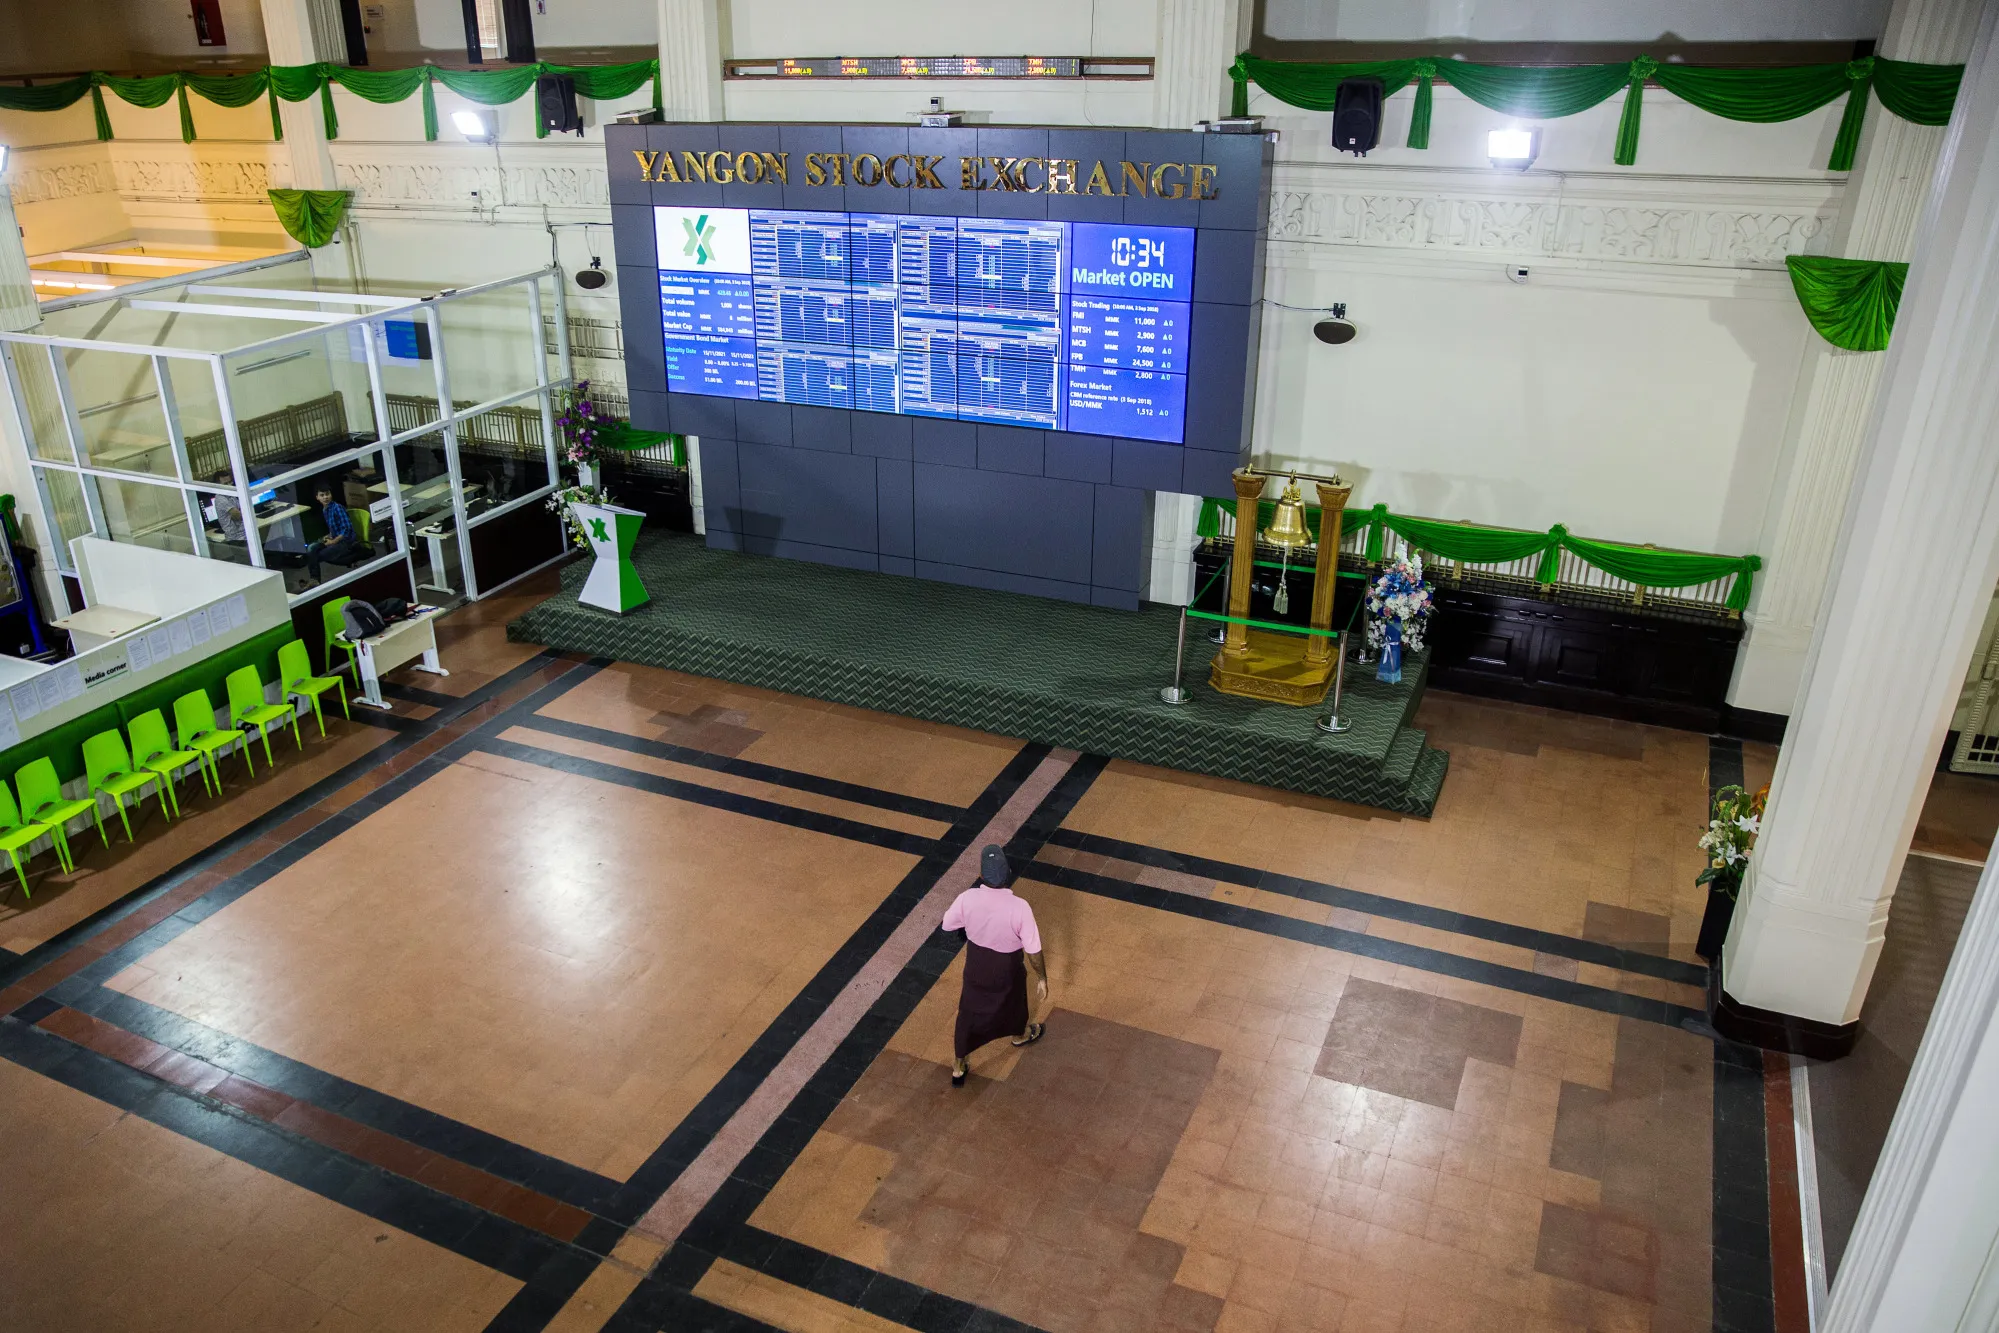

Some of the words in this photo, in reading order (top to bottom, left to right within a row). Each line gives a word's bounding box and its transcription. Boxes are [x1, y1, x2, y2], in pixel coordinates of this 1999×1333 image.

[632, 150, 788, 186] YANGON
[805, 152, 946, 190] STOCK
[958, 156, 1220, 200] EXCHANGE
[1111, 237, 1164, 268] 10:34
[1072, 268, 1126, 286] Market
[1129, 271, 1174, 289] OPEN
[662, 297, 675, 305] Total
[1089, 302, 1110, 311] Trading
[663, 309, 676, 317] Total
[1134, 318, 1155, 326] 11,000
[683, 323, 693, 331] Cap
[665, 333, 695, 341] Government
[1072, 326, 1091, 334] MTSH
[1137, 332, 1155, 340] 2,900
[1072, 339, 1086, 347] MCB
[1137, 346, 1154, 354] 7,600
[1132, 359, 1153, 368] 24,500
[1136, 371, 1152, 380] 2,800
[1089, 382, 1112, 391] Market
[1070, 399, 1102, 409] USD/MMK
[1136, 408, 1153, 416] 1,512
[85, 672, 105, 684] Media
[106, 663, 126, 675] corner
